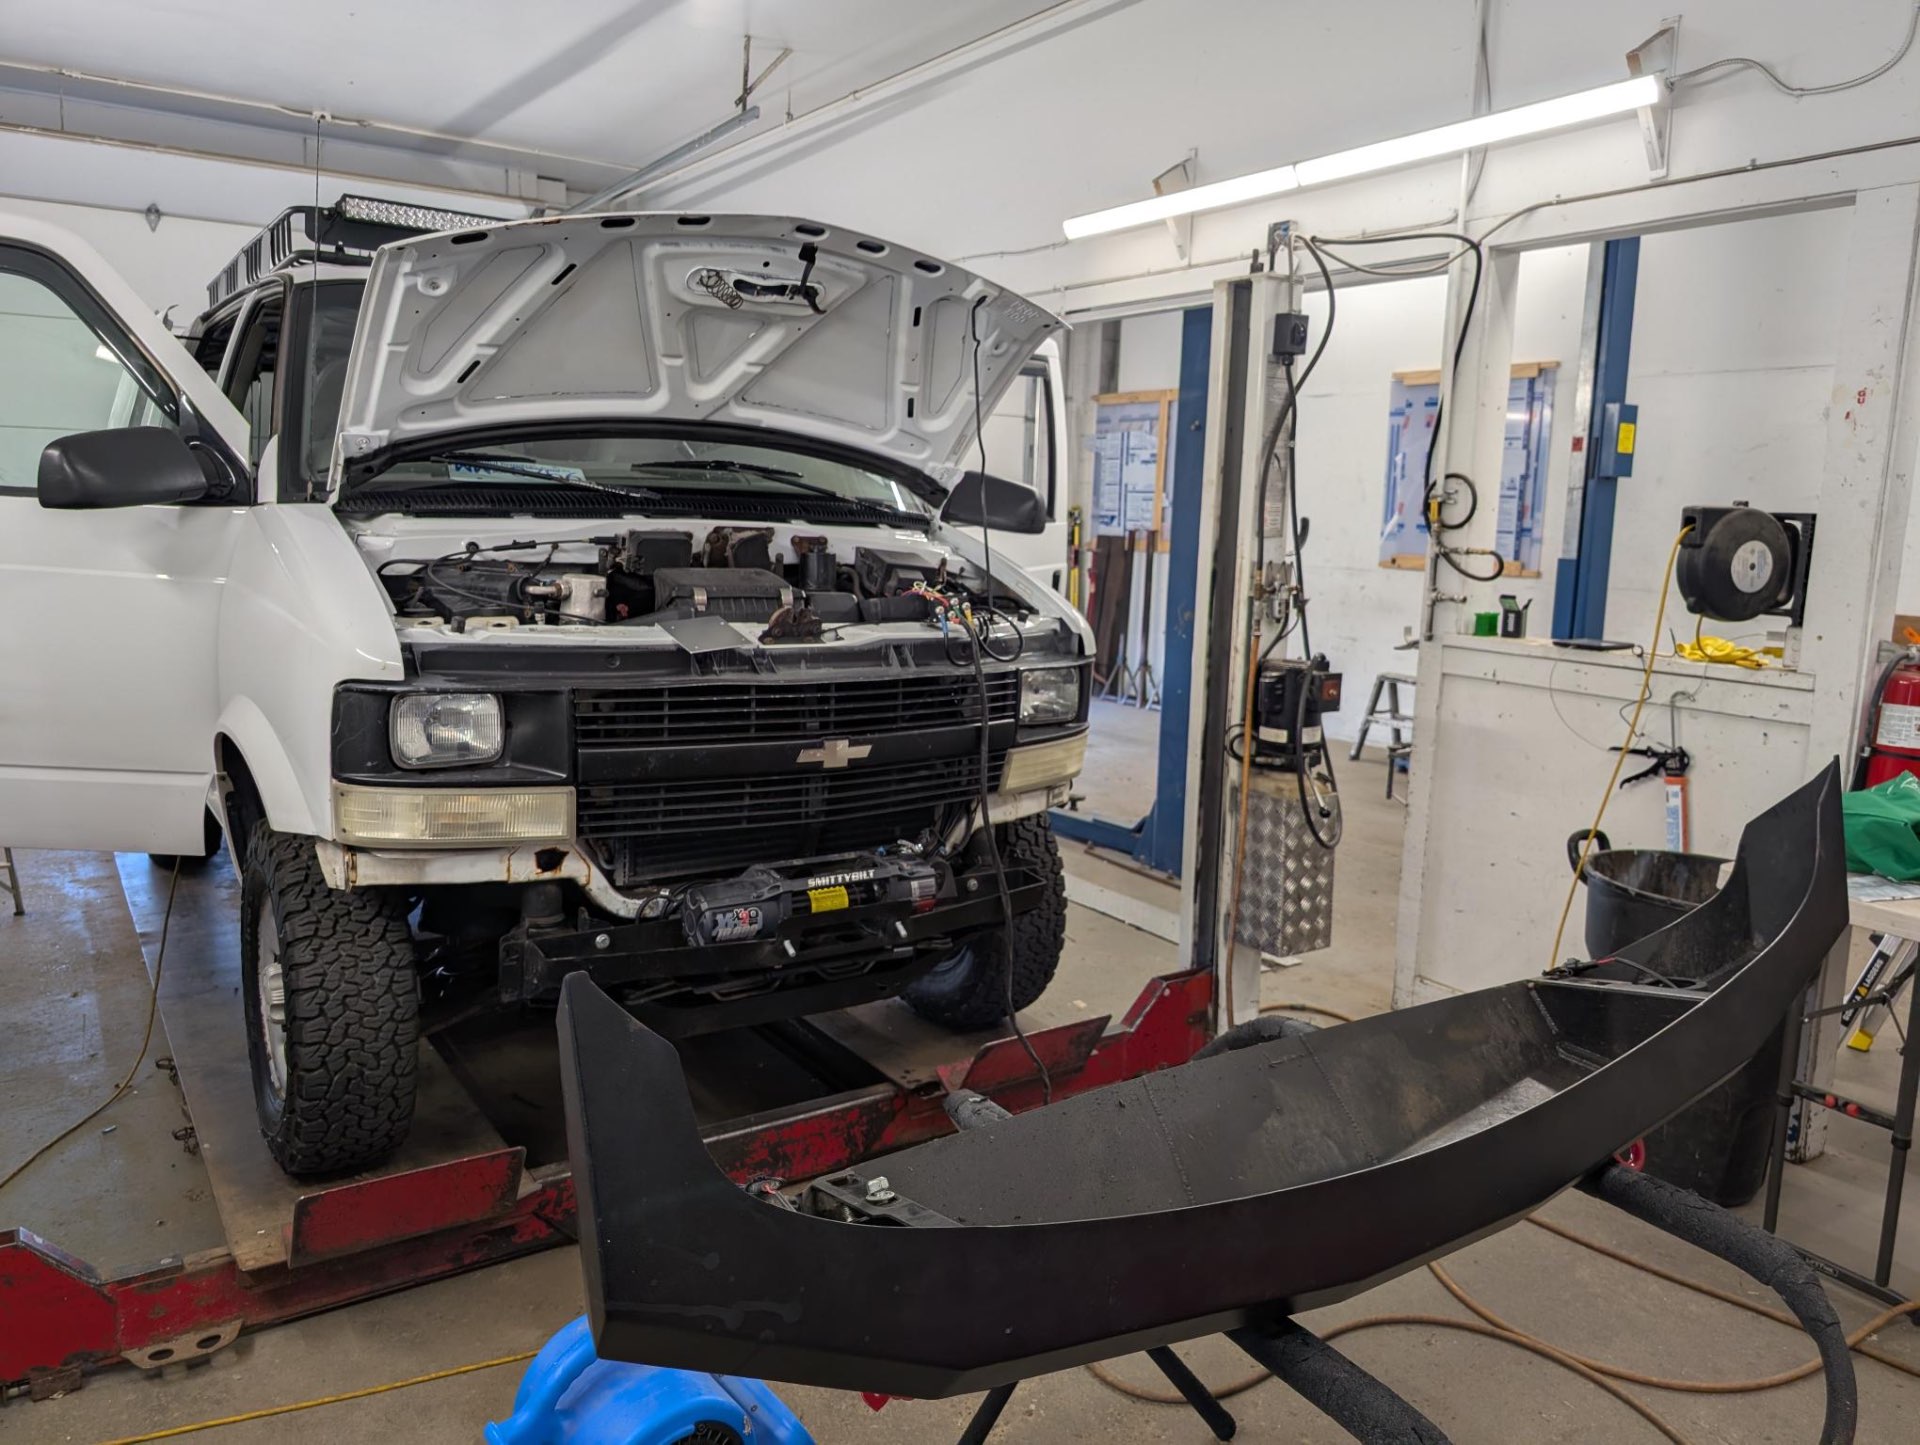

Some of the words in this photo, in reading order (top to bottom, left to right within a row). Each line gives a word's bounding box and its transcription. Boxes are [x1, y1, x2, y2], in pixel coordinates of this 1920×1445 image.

[808, 869, 875, 887] SMITTYBILT
[1842, 995, 1862, 1021] GORA
[1863, 959, 1884, 987] LADDERS
